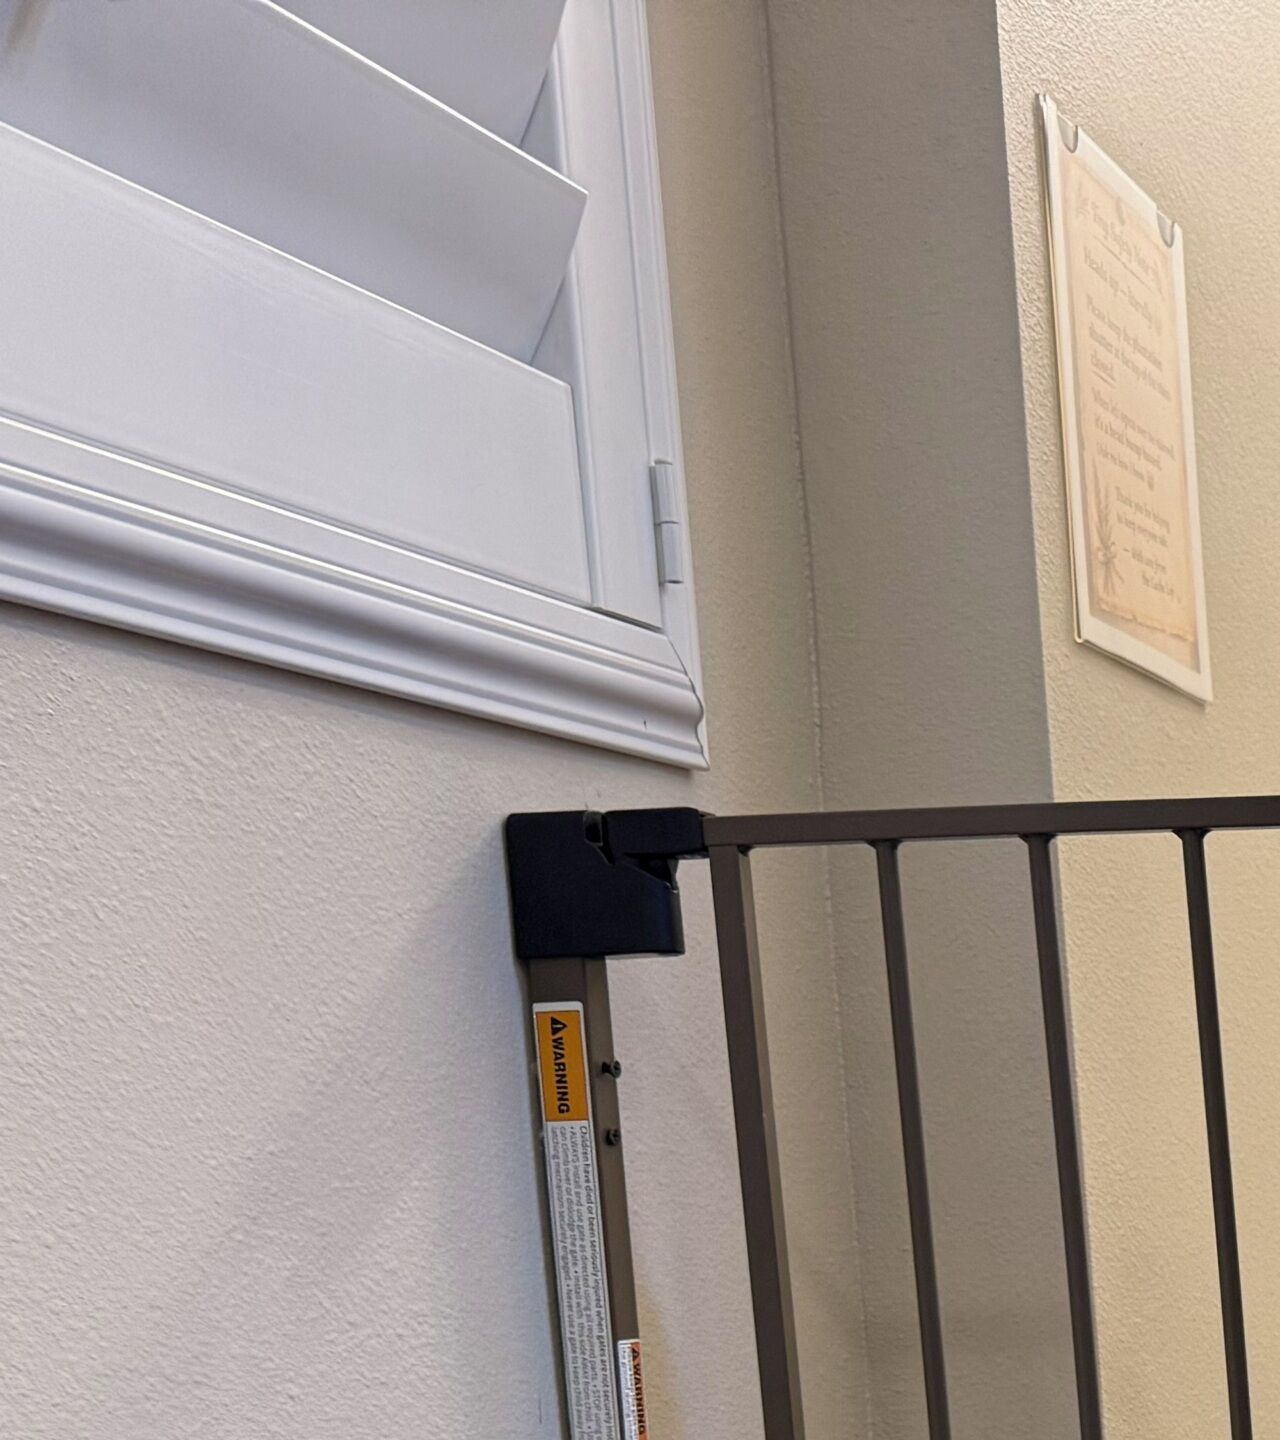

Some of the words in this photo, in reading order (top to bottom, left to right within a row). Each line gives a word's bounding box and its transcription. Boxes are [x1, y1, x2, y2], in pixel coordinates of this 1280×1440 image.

[552, 1037, 570, 1114] WARNING
[569, 1131, 579, 1162] ALWAYS
[583, 1163, 591, 1183] have
[574, 1190, 582, 1206] and
[585, 1185, 593, 1204] died
[563, 1167, 571, 1184] over
[569, 1234, 577, 1248] the
[576, 1208, 584, 1222] use
[576, 1224, 585, 1242] gate
[587, 1216, 596, 1238] been
[588, 1240, 599, 1276] seriously
[580, 1254, 589, 1288] directed
[591, 1278, 602, 1308] injured
[595, 1310, 604, 1333] when
[596, 1335, 606, 1357] gates
[599, 1359, 607, 1372] are
[600, 1373, 608, 1388] not
[591, 1389, 600, 1411] STOP
[601, 1389, 612, 1424] securely
